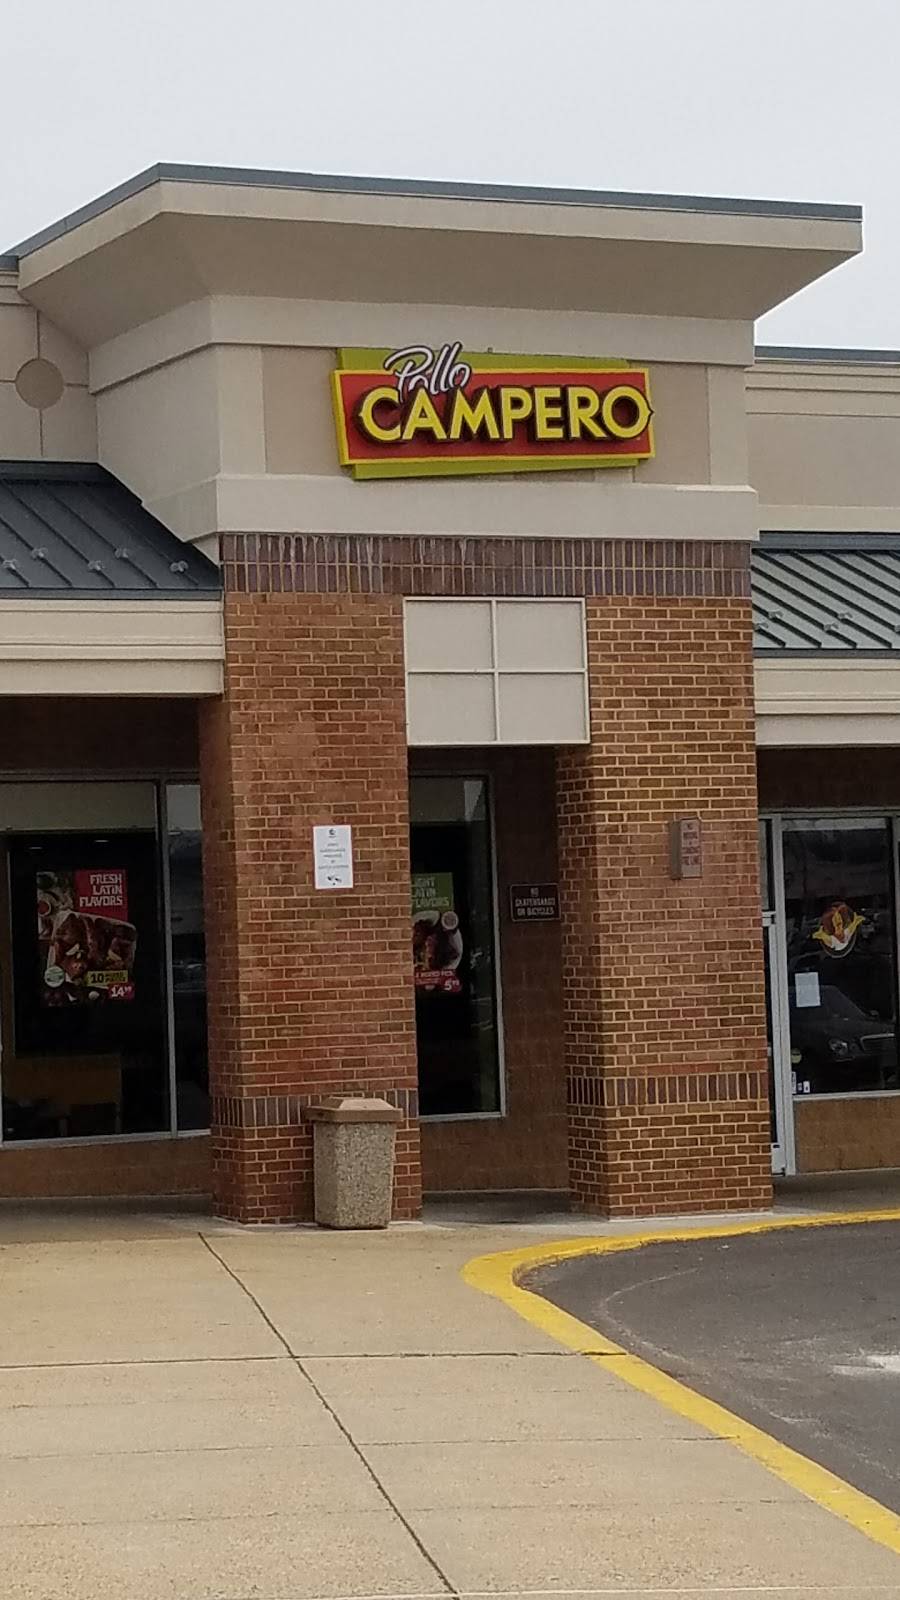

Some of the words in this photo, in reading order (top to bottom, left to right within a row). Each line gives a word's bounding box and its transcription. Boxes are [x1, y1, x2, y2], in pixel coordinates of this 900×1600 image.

[383, 341, 472, 404] Pollo
[357, 384, 652, 442] CAMPERO
[90, 873, 122, 885] FRESH
[92, 884, 122, 895] LATIN
[80, 895, 123, 907] FLAVORS
[90, 973, 104, 983] 10
